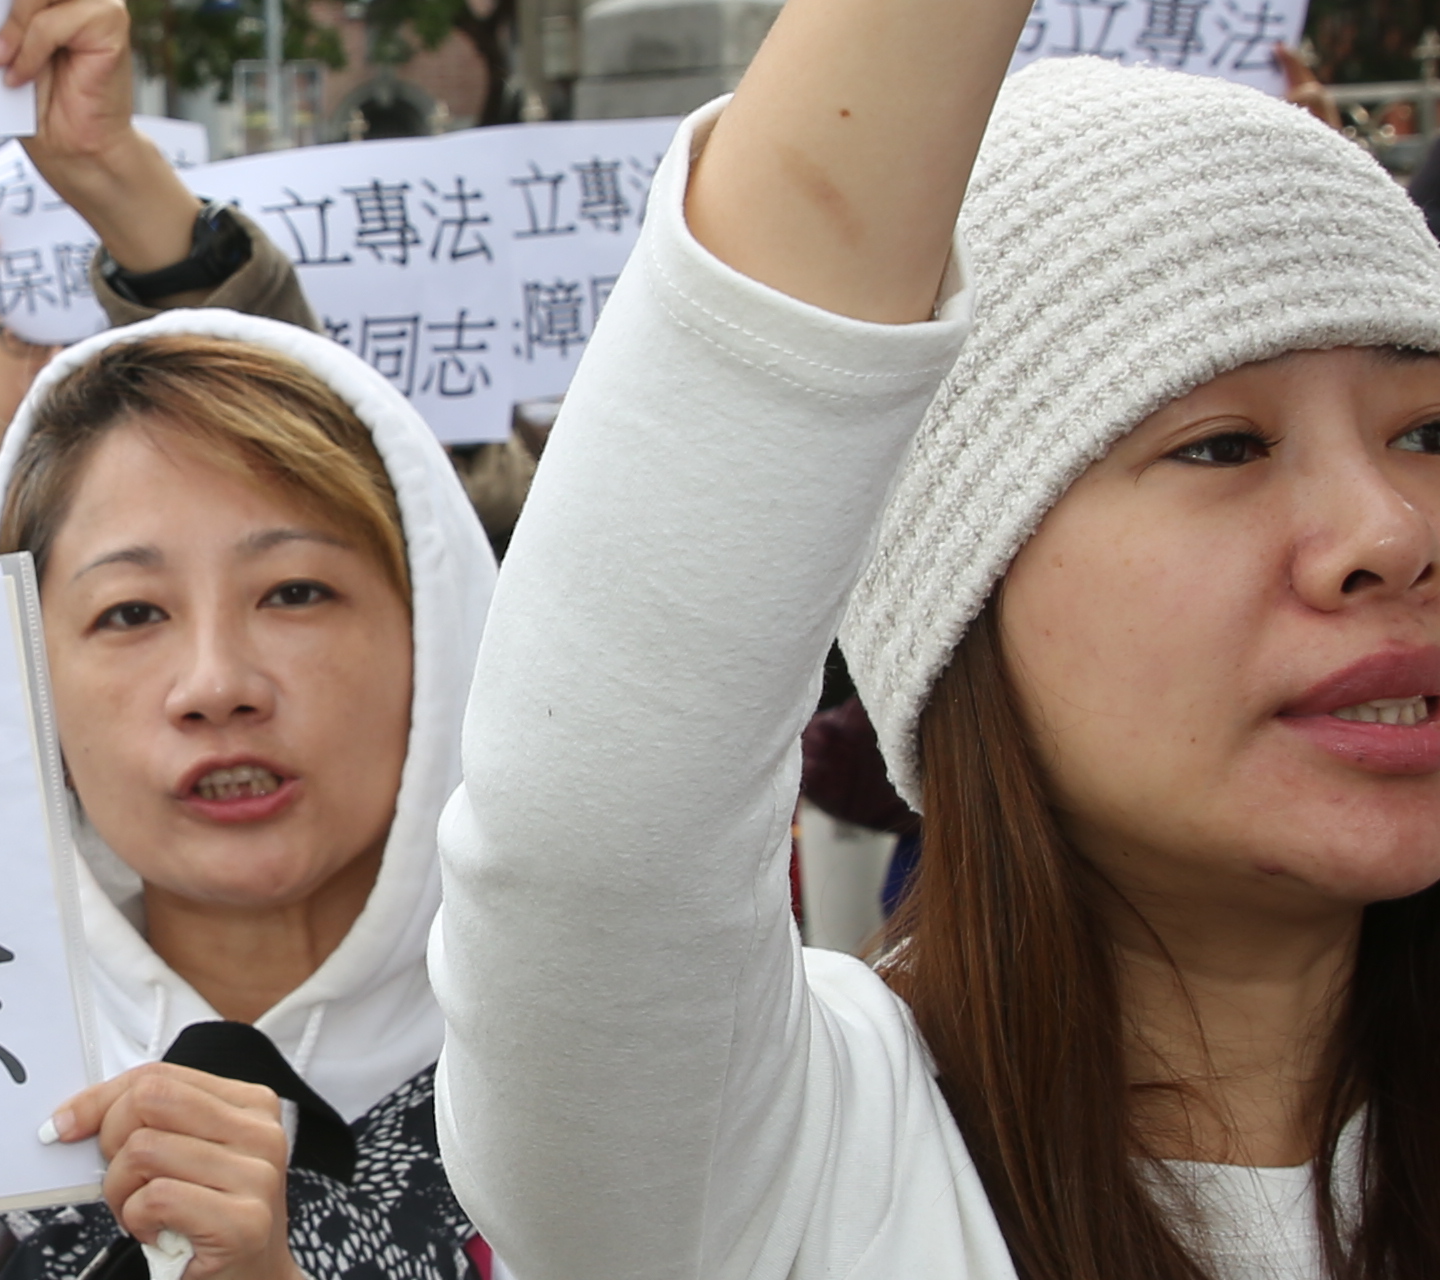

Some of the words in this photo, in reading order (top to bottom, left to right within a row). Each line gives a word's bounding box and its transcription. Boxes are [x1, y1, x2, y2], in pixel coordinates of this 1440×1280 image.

[230, 176, 495, 268] 立專法
[322, 310, 497, 399] 同志
